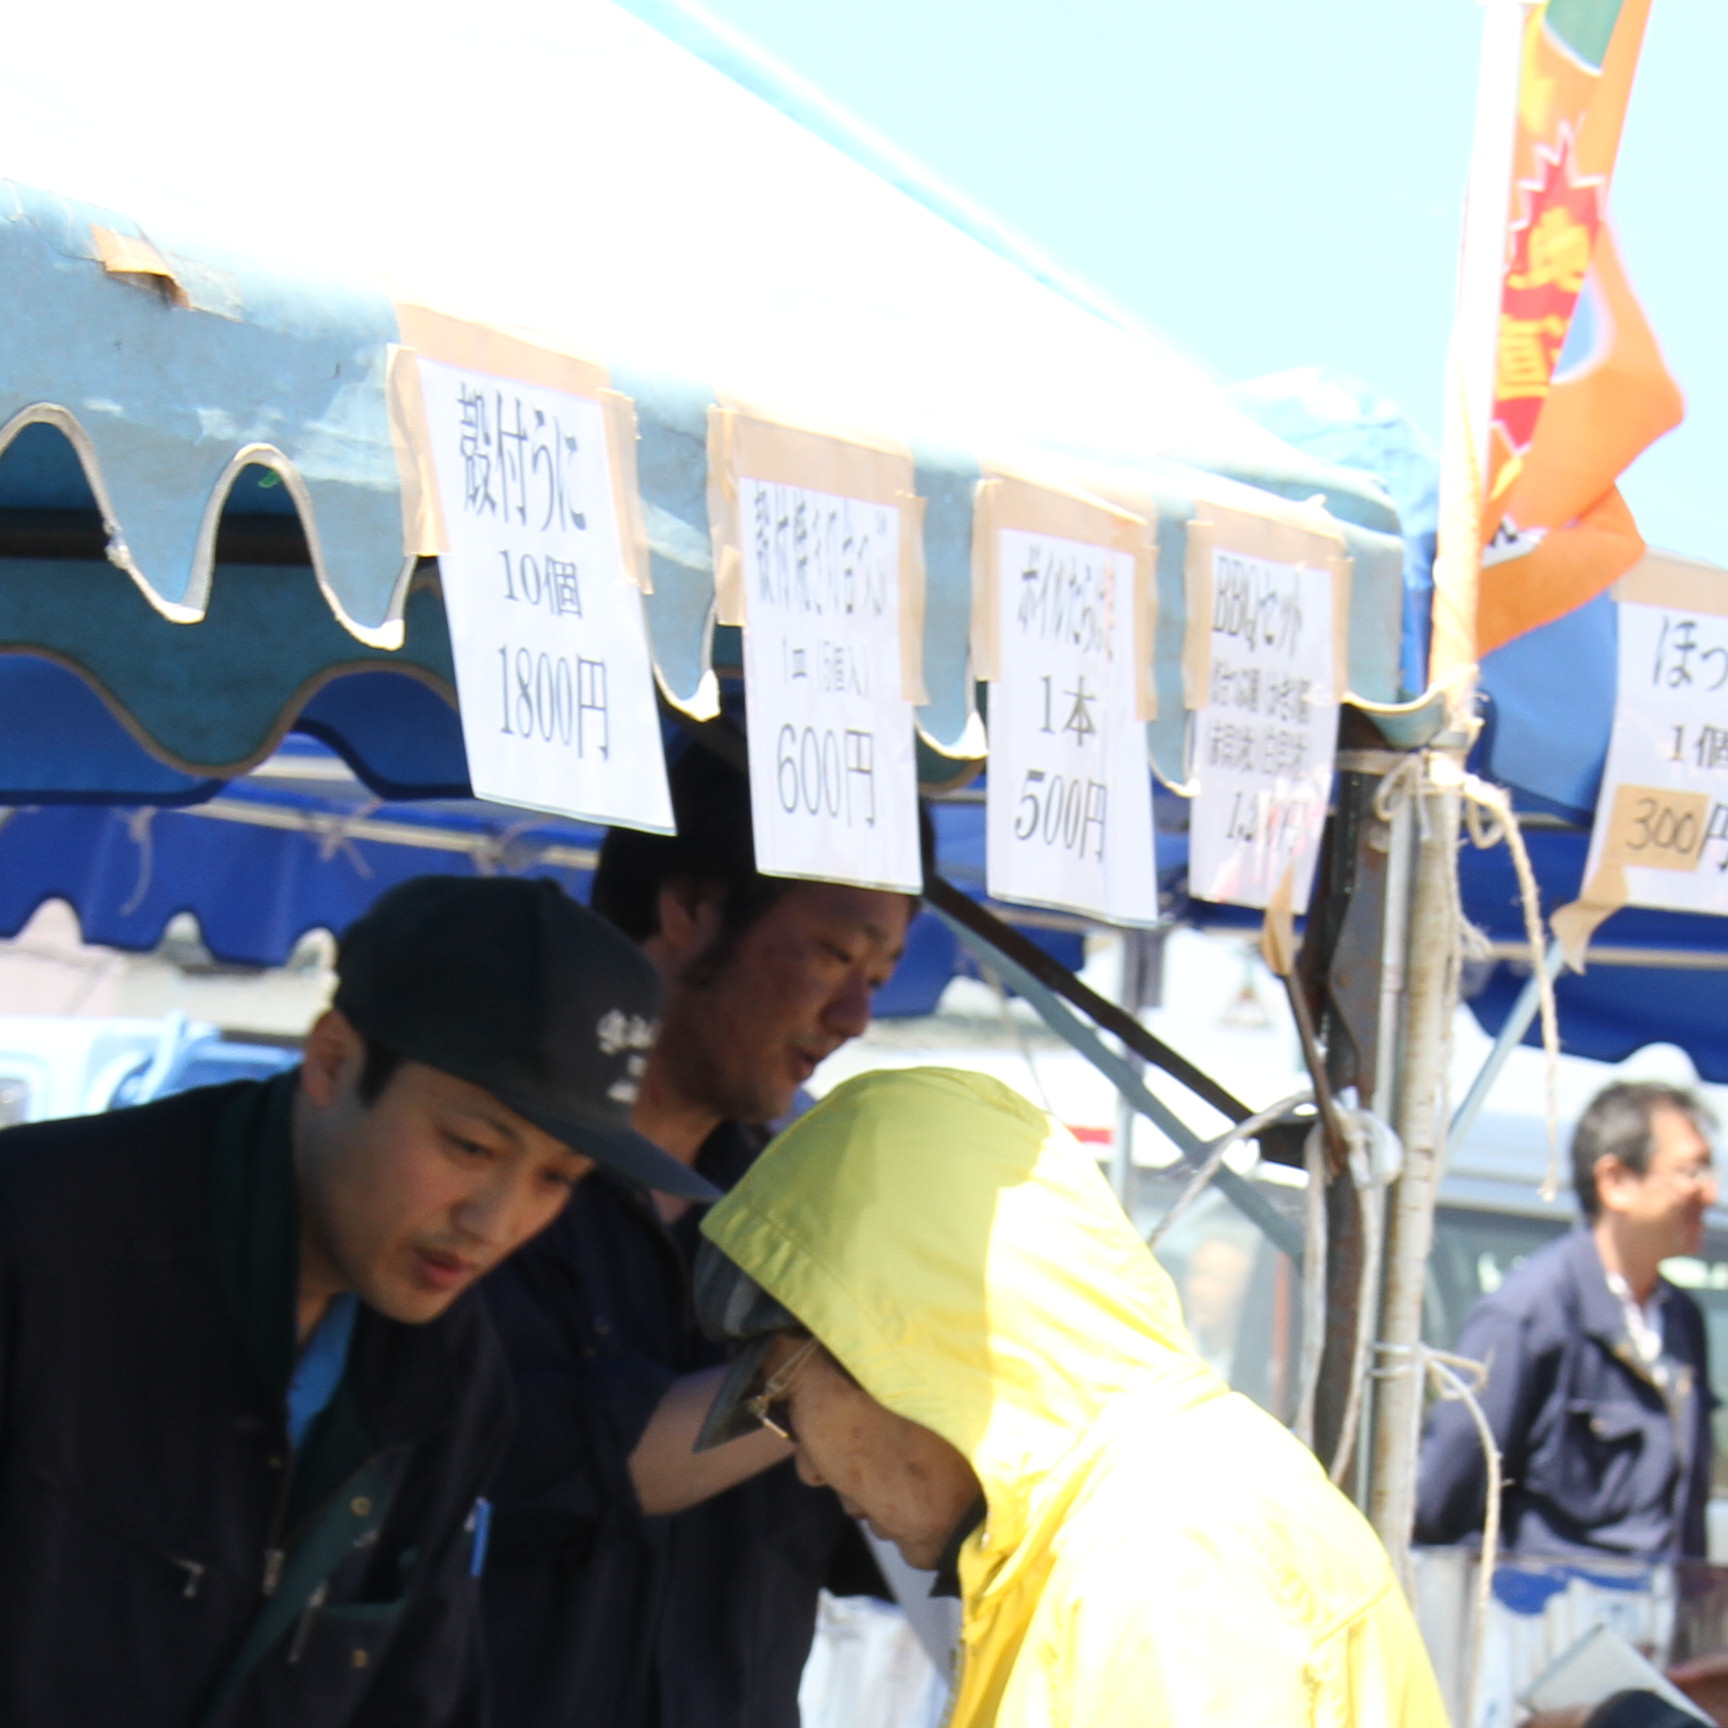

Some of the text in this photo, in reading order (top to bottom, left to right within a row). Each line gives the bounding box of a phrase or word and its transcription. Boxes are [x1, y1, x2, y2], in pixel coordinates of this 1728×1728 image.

[456, 381, 587, 532] 殻付うに
[499, 549, 583, 620] 10個
[498, 644, 609, 761] 1800円
[1039, 675, 1097, 747] 1本
[777, 723, 876, 829] 600円
[1014, 768, 1107, 863] 500円
